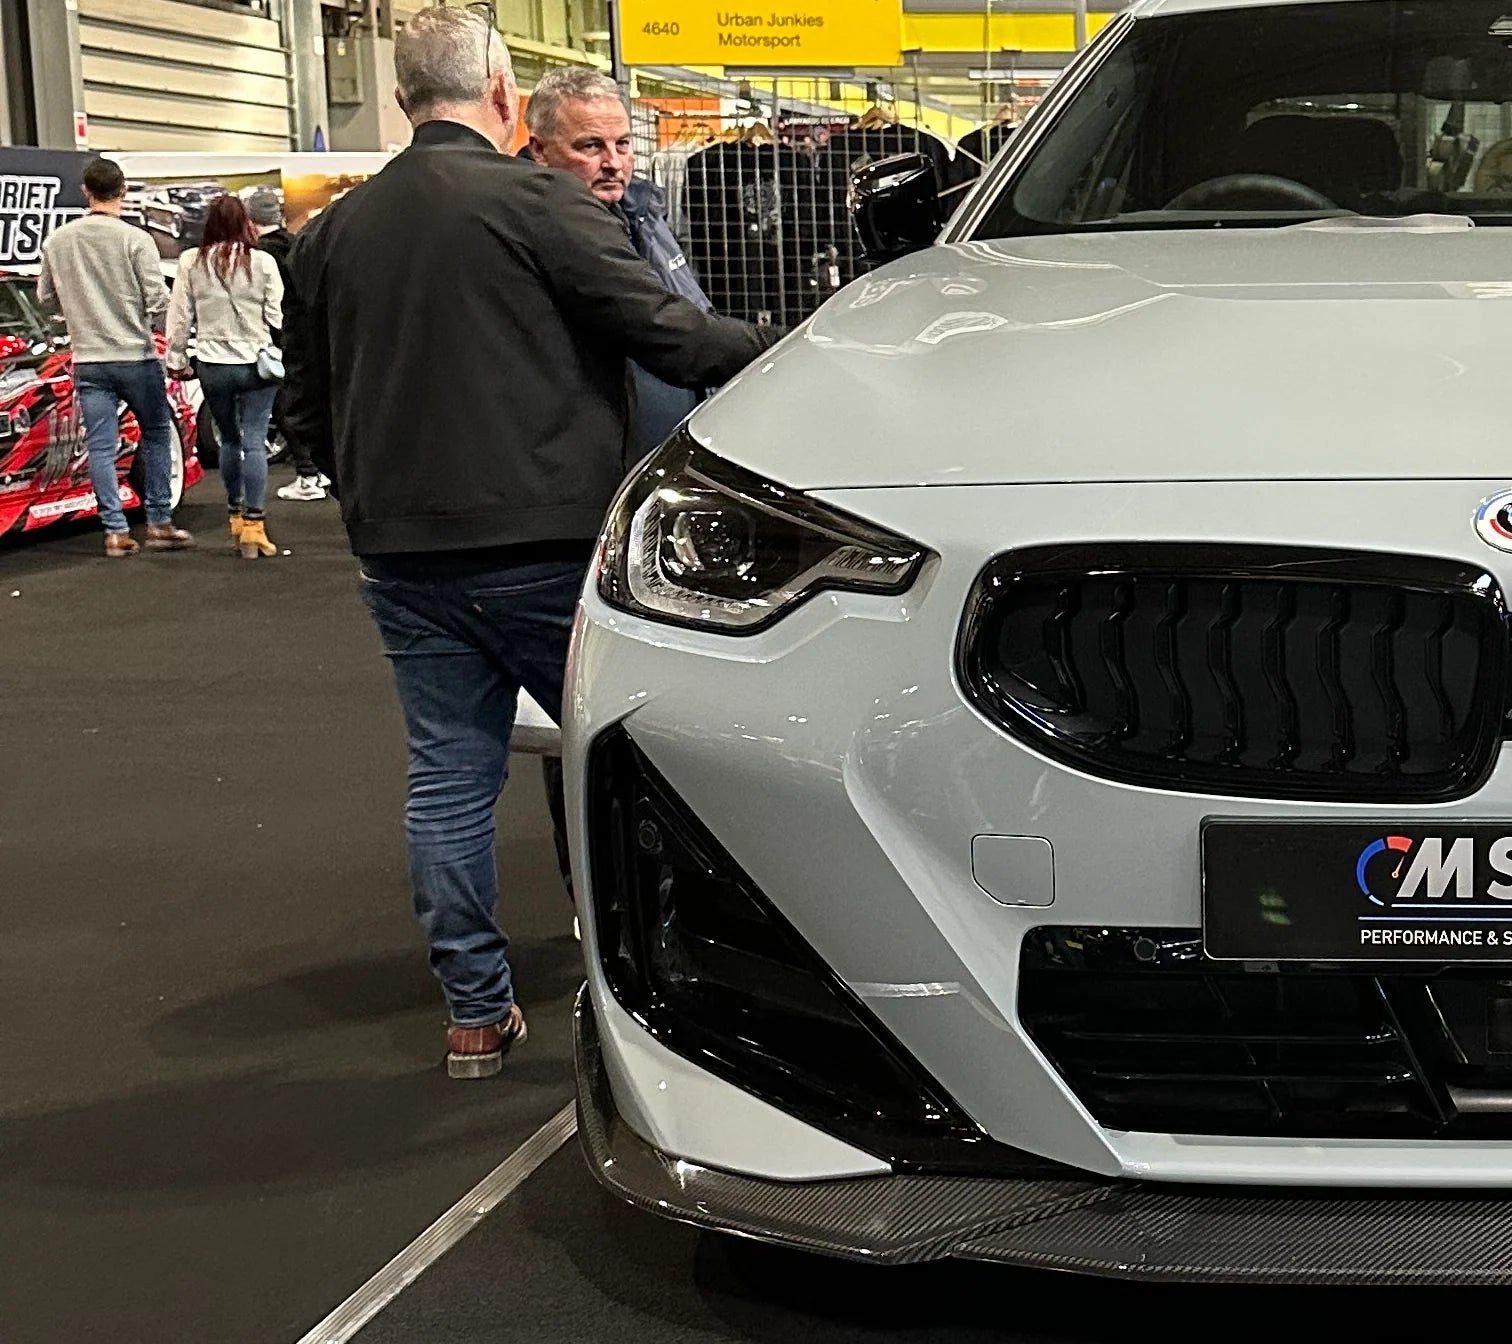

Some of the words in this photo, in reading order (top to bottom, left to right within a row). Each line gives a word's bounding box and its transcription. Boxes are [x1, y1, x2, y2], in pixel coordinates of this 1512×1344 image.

[717, 13, 763, 27] Urban
[767, 13, 824, 27] Junkies
[642, 22, 680, 36] 4640
[718, 33, 801, 49] Motorsport
[0, 177, 59, 211] RIFT
[1360, 929, 1483, 945] PERFORMANCE
[1487, 930, 1499, 945] &
